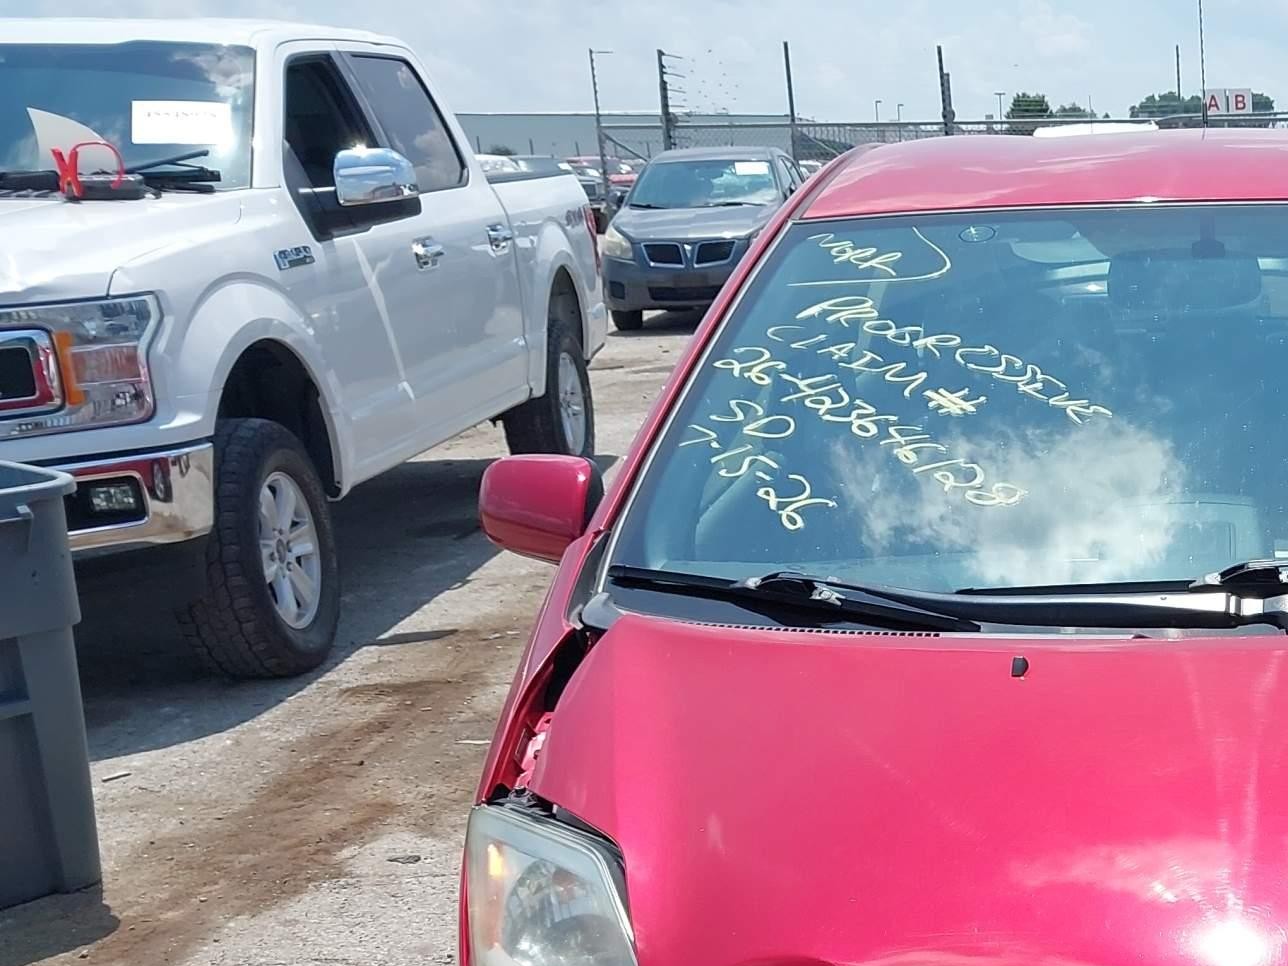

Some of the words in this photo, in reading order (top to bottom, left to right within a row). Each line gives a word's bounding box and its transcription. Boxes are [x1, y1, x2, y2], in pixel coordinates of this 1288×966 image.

[1208, 94, 1220, 111] A
[1235, 94, 1247, 111] B
[766, 325, 928, 399] CLAIM
[922, 387, 988, 416] #
